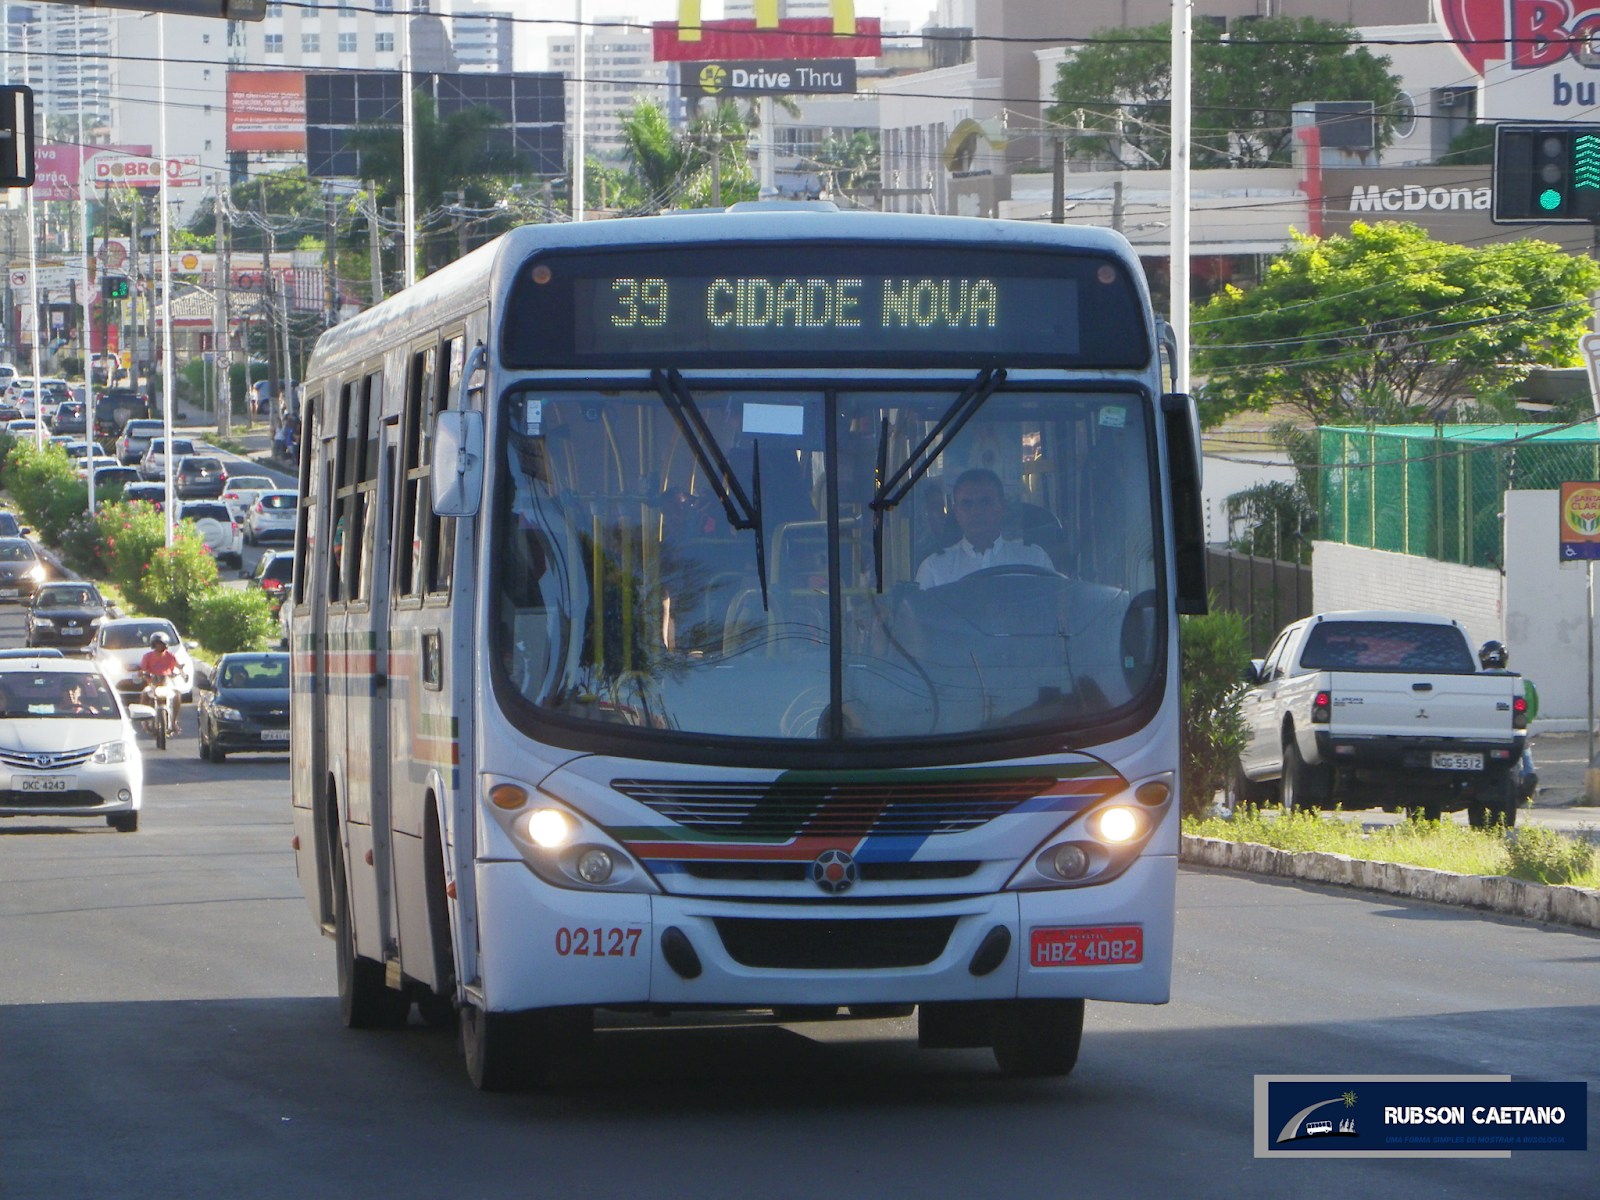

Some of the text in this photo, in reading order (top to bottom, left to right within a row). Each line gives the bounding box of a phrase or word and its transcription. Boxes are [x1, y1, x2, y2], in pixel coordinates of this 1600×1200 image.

[732, 68, 842, 88] Drive Thru
[611, 278, 998, 327] 39 CIDADE NOVA
[555, 927, 642, 957] 02127
